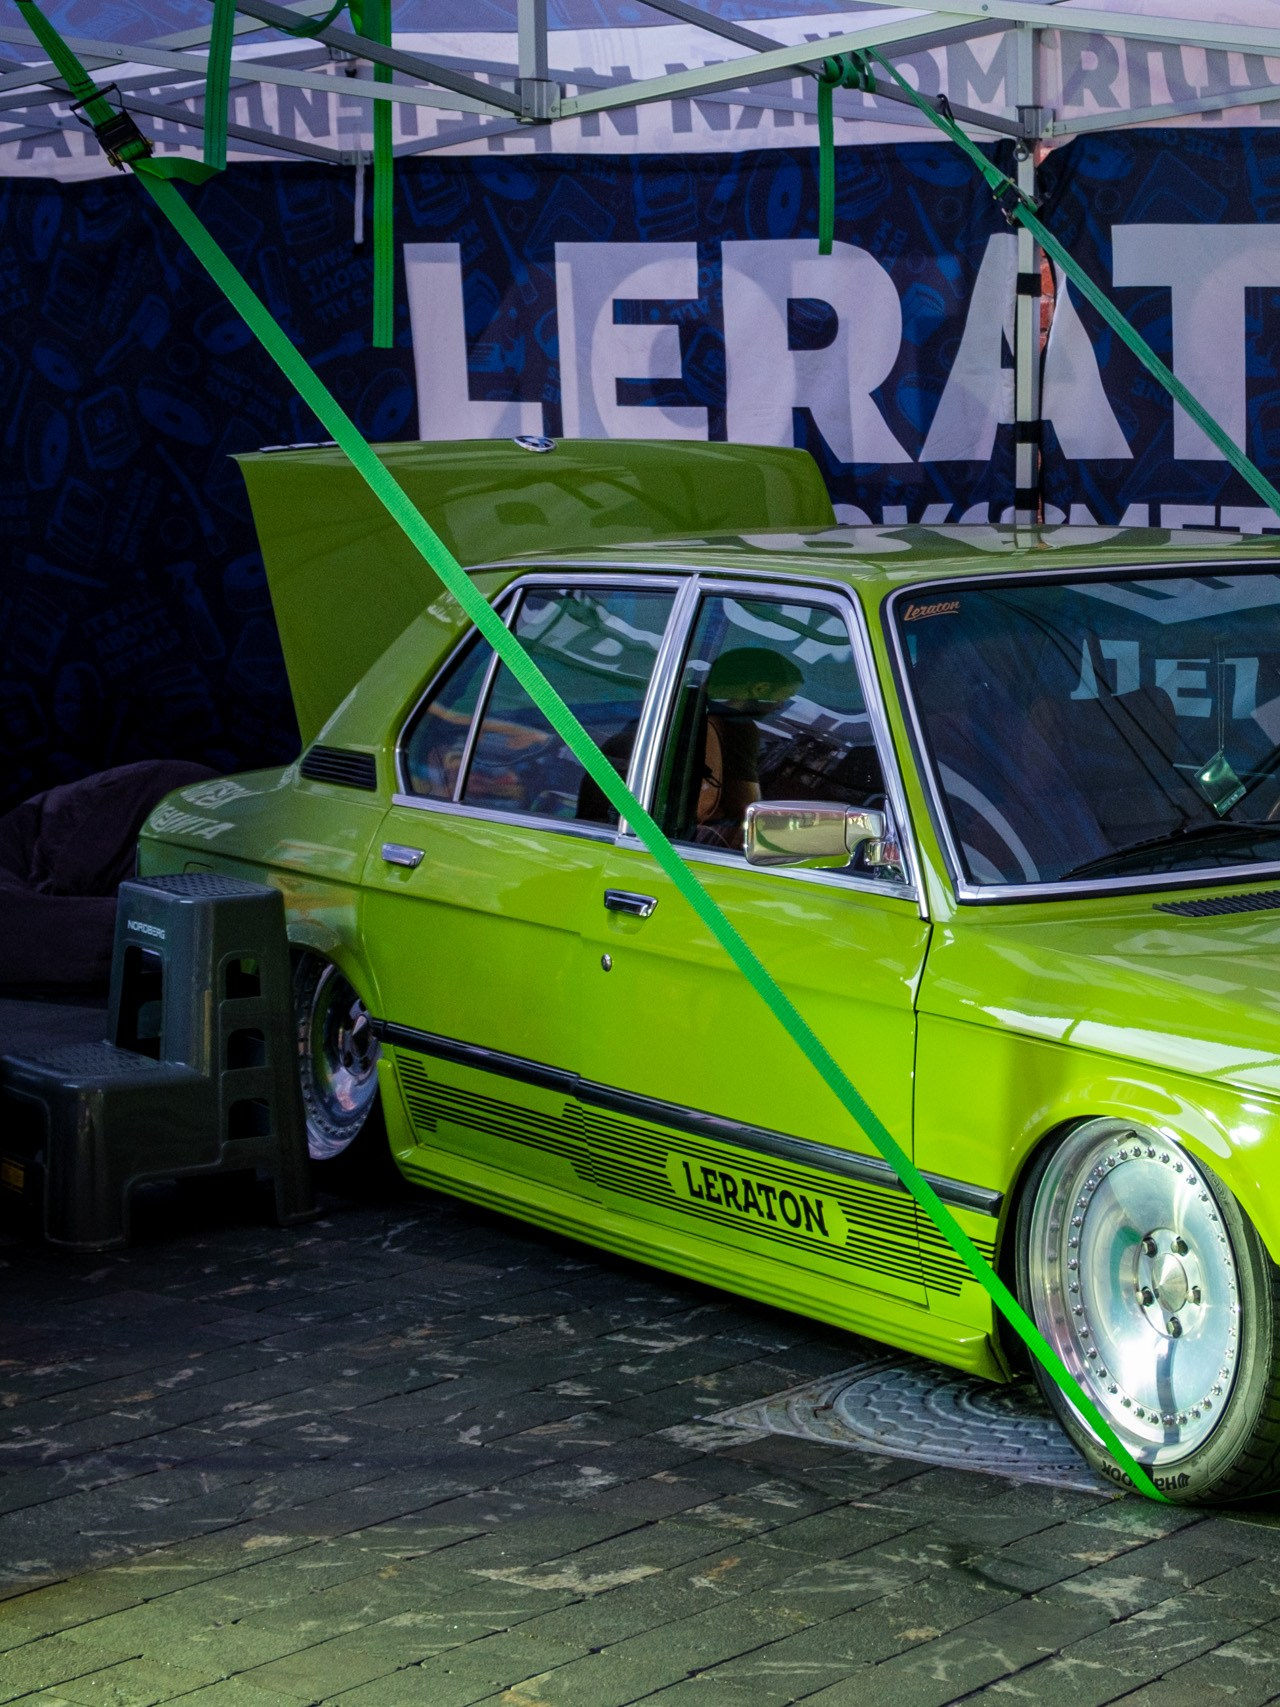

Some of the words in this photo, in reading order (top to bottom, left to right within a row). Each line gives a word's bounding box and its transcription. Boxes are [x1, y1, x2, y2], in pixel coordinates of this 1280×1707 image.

[904, 601, 960, 621] Leraton
[127, 919, 166, 940] NORDBERG
[682, 1160, 829, 1237] LERATON
